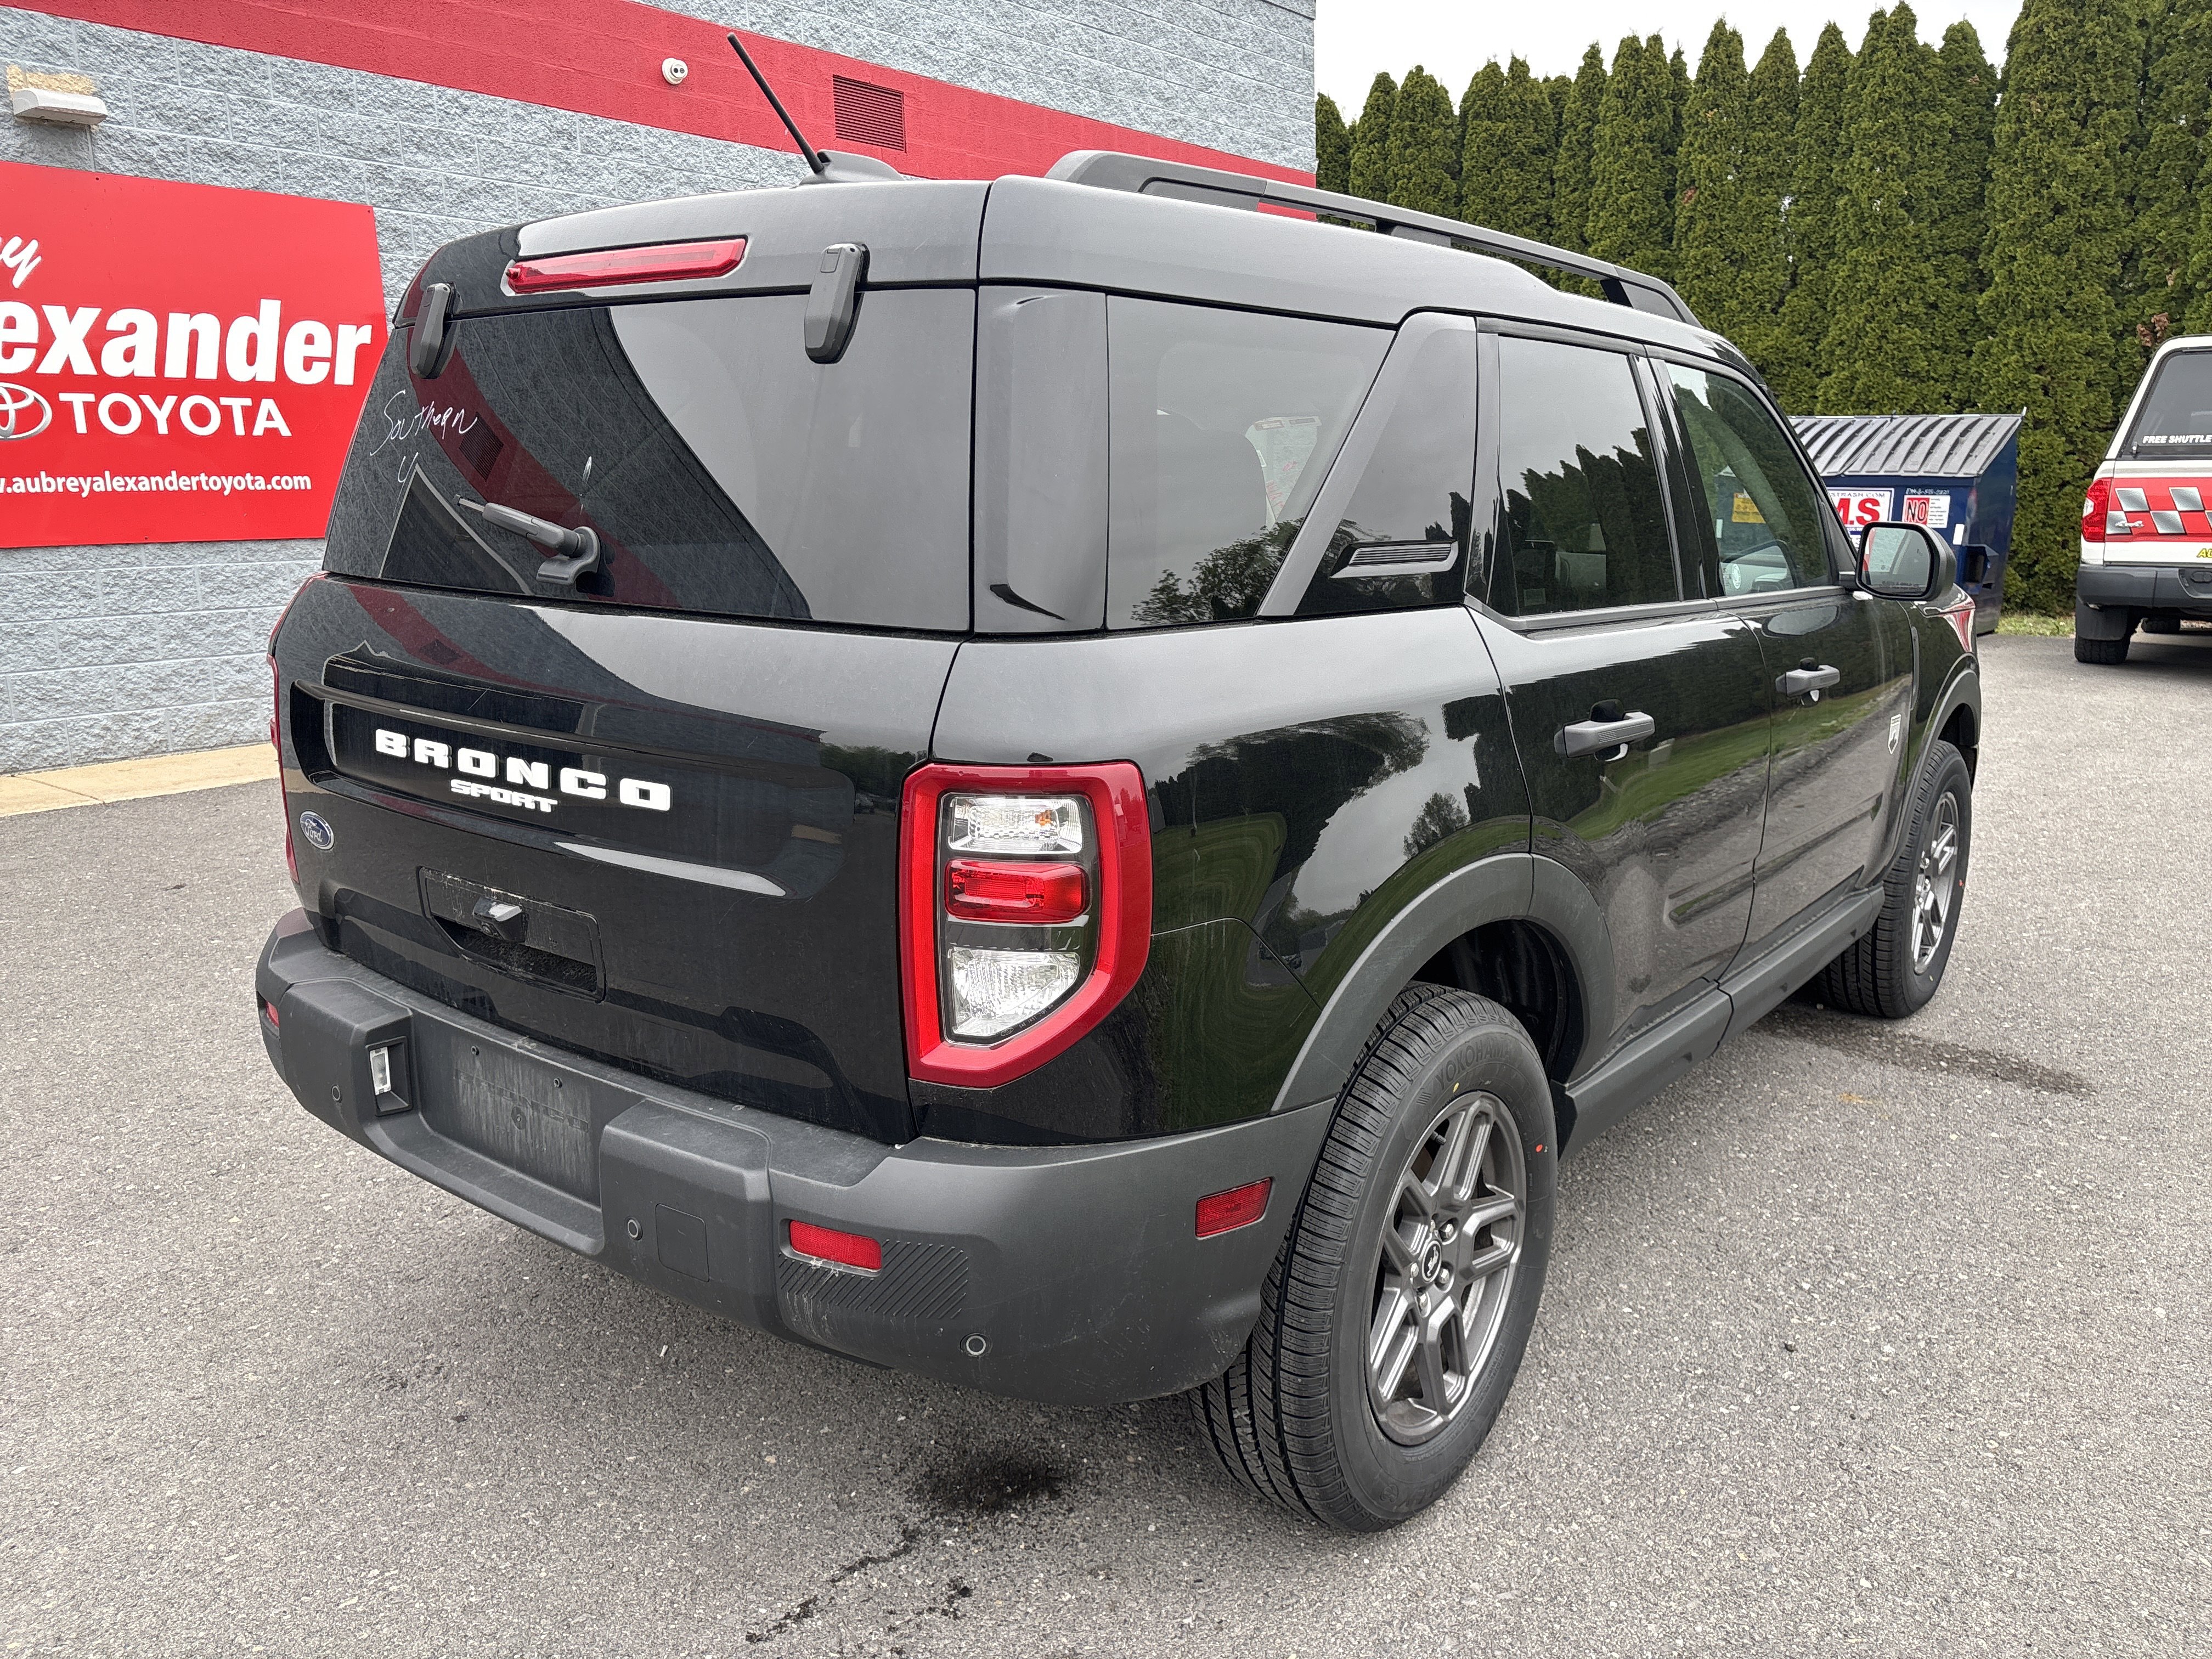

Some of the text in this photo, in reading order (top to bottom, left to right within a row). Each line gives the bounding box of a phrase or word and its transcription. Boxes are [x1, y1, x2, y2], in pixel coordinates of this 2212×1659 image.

[59, 392, 292, 437] TOYOTA
[2142, 435, 2212, 444] FREE SHUTTLE
[1905, 499, 1927, 523] NO
[375, 728, 674, 811] BRONCO
[450, 778, 558, 812] SPORT
[304, 818, 323, 842] Ford
